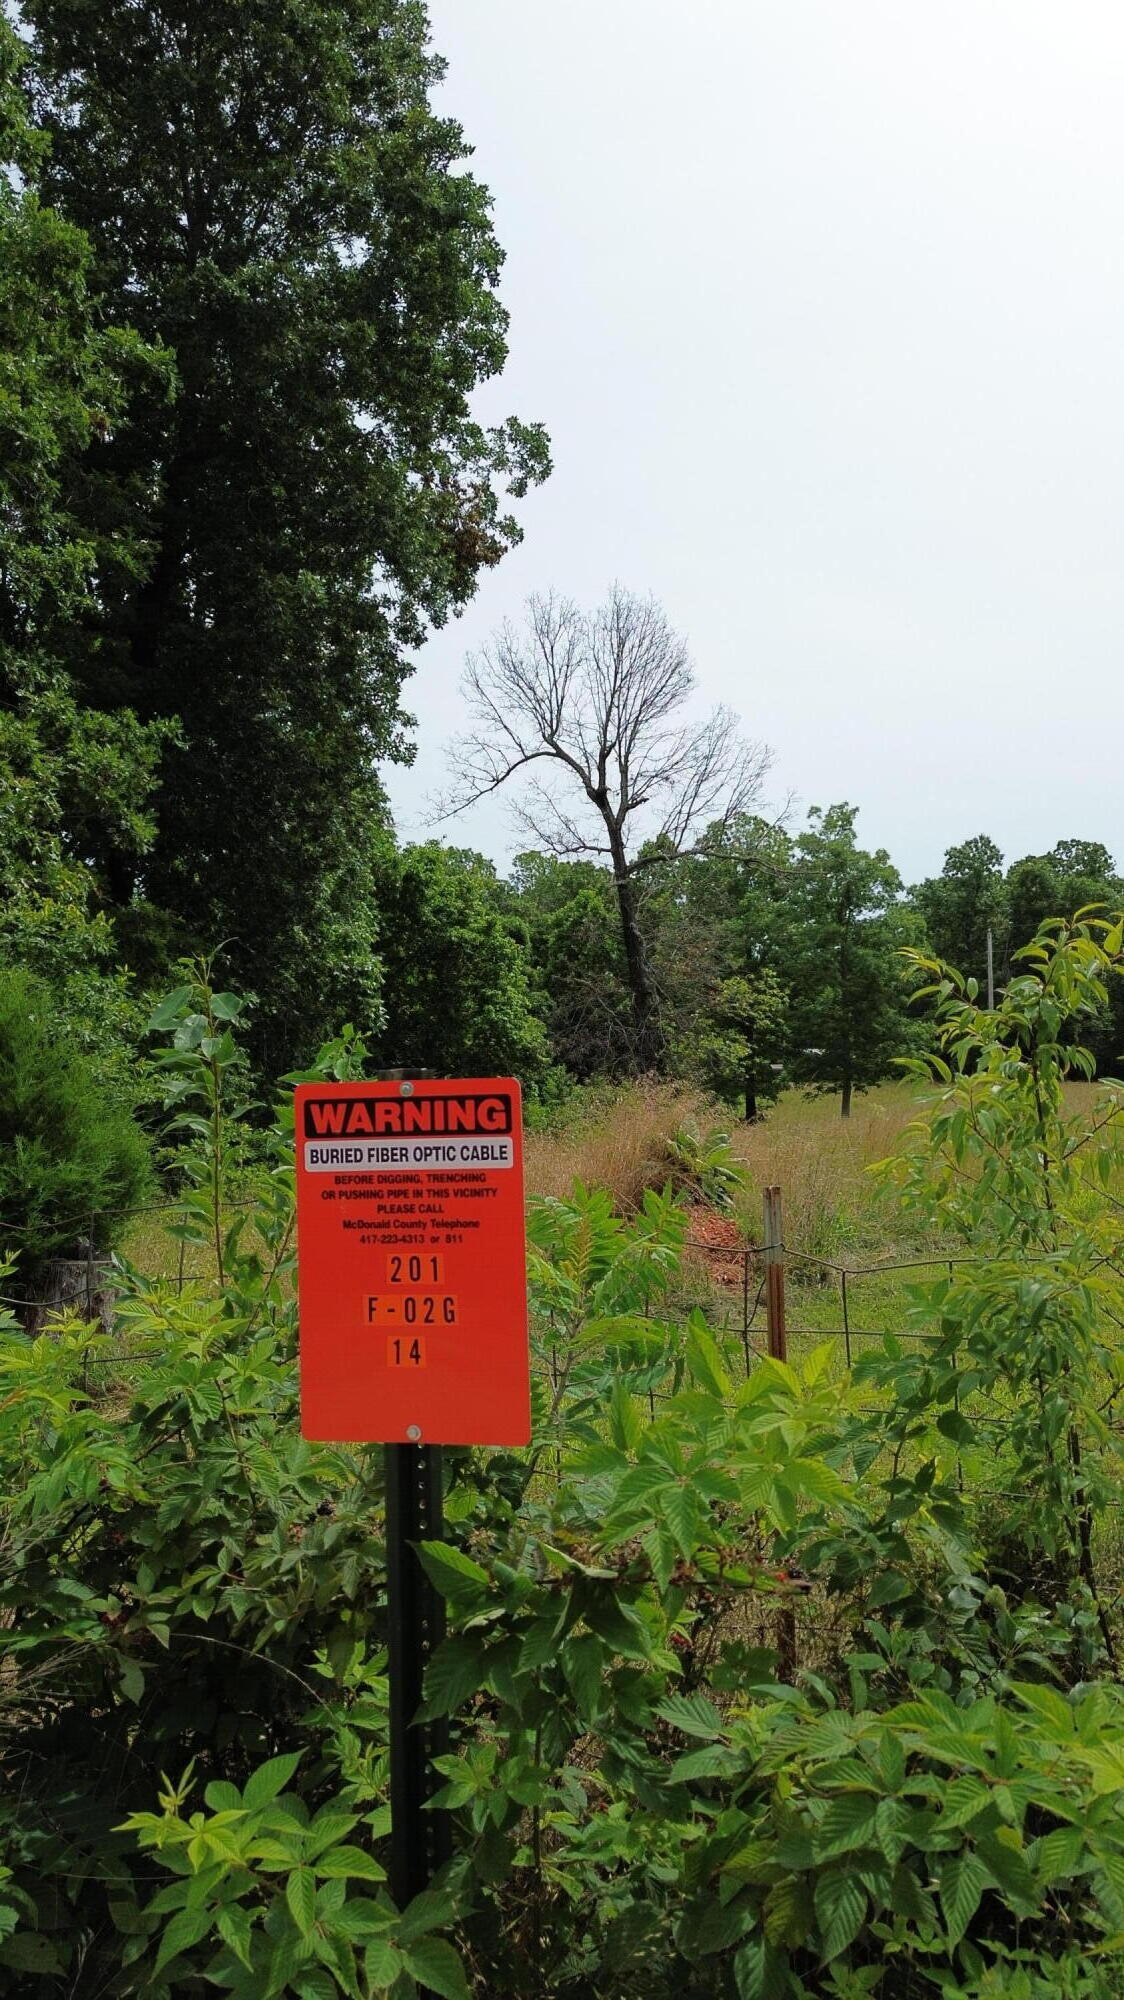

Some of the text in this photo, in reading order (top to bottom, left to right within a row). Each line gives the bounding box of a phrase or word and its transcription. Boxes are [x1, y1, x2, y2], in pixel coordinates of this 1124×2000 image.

[309, 1098, 507, 1134] WARNING
[310, 1145, 508, 1164] BURIED FIBER OPTIC CABLE
[334, 1175, 374, 1185] BEFORE
[427, 1173, 487, 1183] TRENCHING
[321, 1188, 498, 1200] OR PUSHING PIPE IN THIS VICINITY
[377, 1203, 444, 1214] PLEASE CALL
[343, 1218, 480, 1230] McDonald County Telephone
[430, 1235, 440, 1243] or
[390, 1255, 438, 1283] 201
[368, 1297, 455, 1323] F-02G
[393, 1339, 421, 1365] 14
